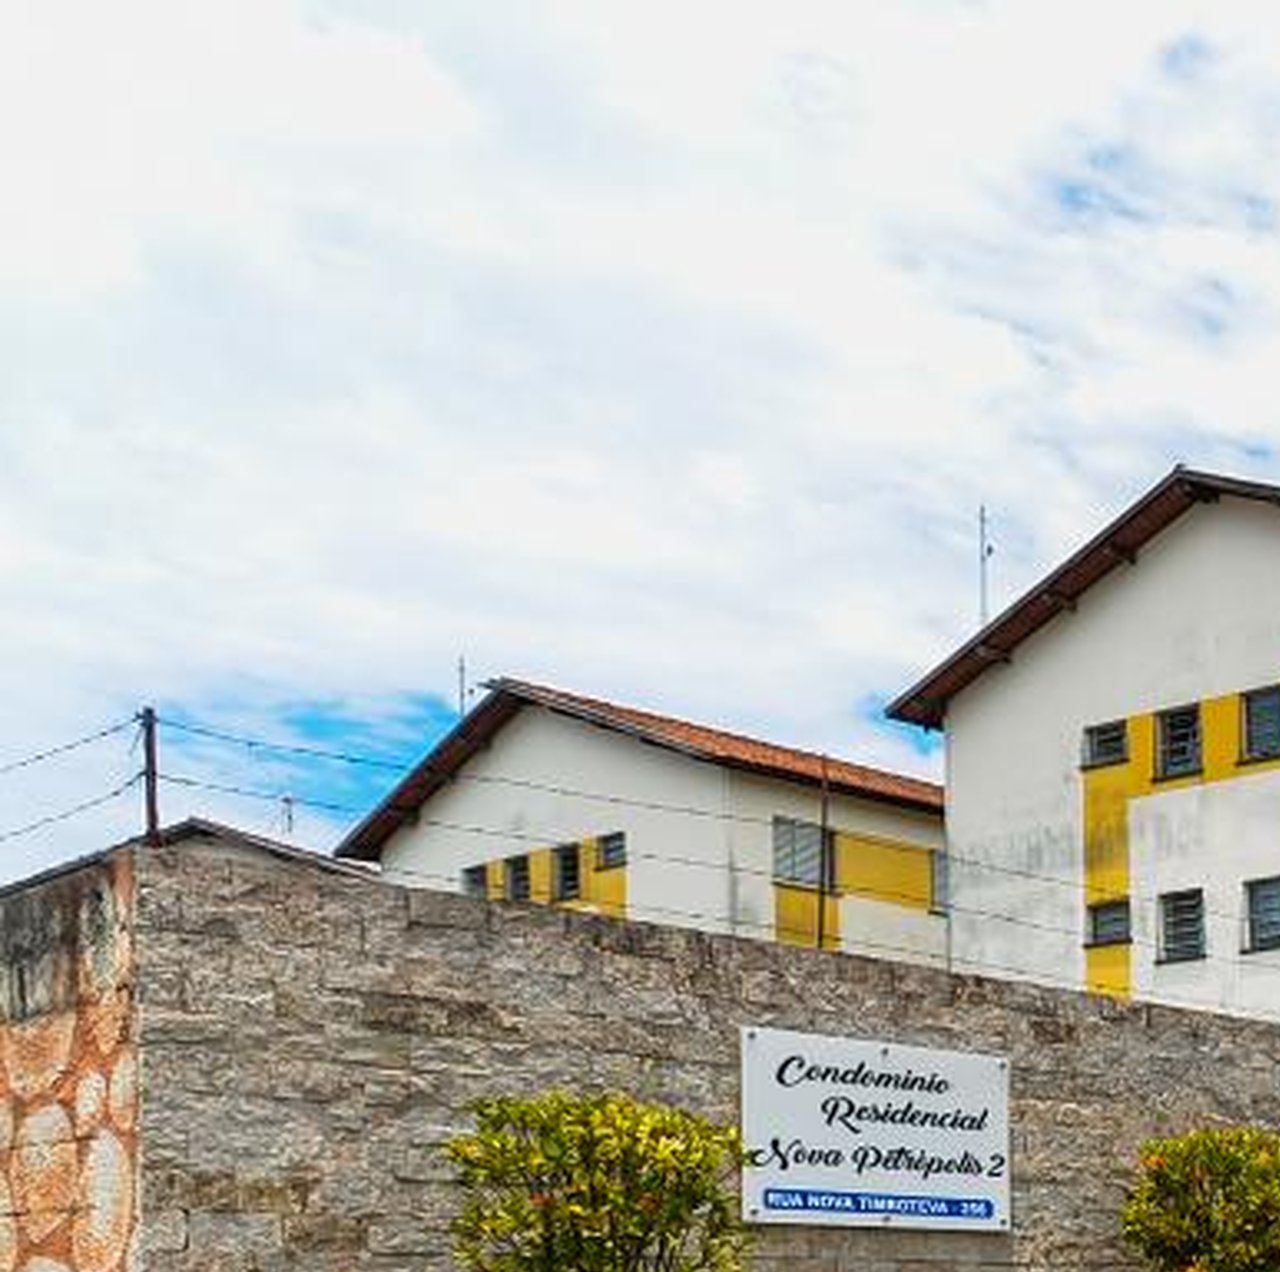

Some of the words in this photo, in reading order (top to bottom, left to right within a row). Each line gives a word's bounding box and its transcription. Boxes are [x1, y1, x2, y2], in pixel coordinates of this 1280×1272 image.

[821, 1096, 988, 1134] Residencial
[750, 1138, 844, 1170] Nova
[987, 1153, 1005, 1177] 2
[768, 1192, 803, 1208] RUA
[807, 1193, 853, 1209] NOVA
